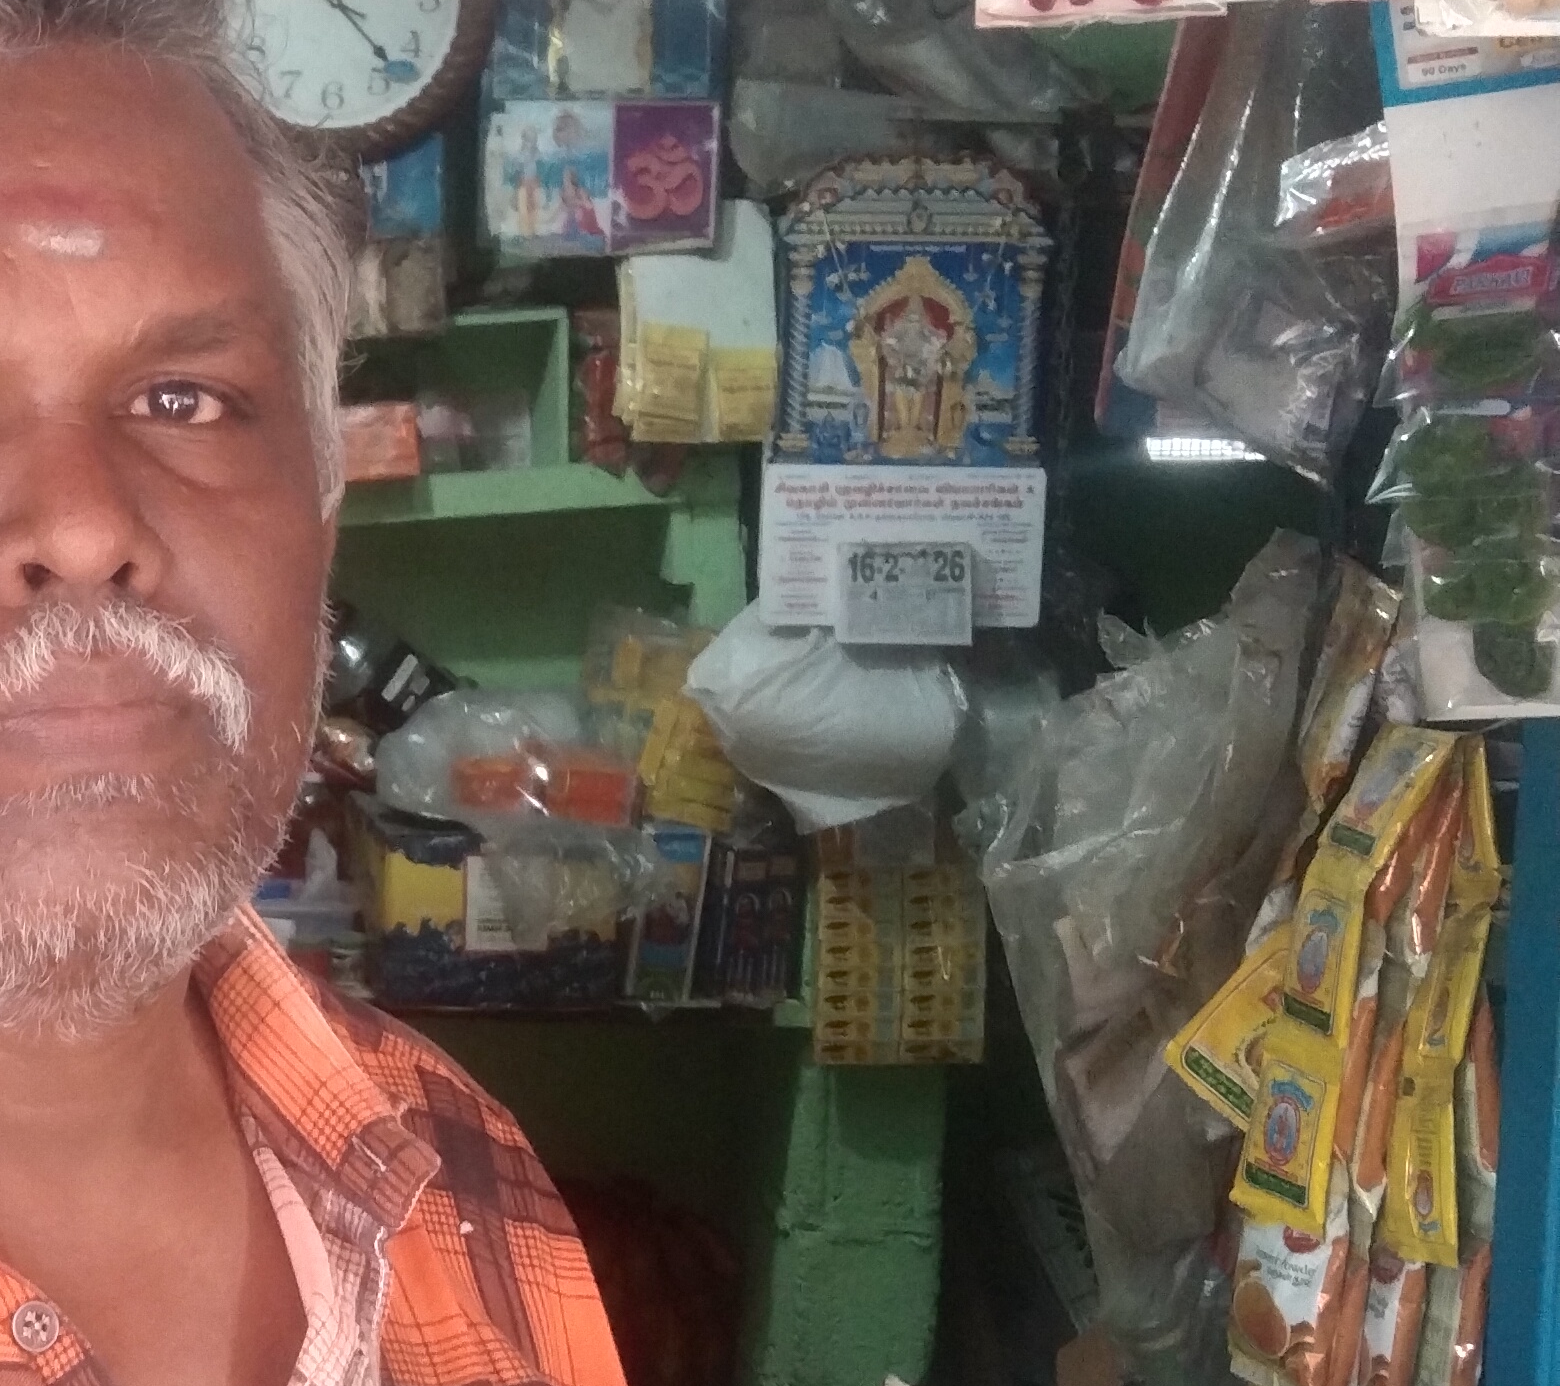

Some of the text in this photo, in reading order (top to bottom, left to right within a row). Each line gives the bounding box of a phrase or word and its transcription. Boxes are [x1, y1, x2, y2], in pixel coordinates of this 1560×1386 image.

[400, 29, 422, 58] 4
[281, 69, 303, 98] 7
[321, 81, 345, 110] 6
